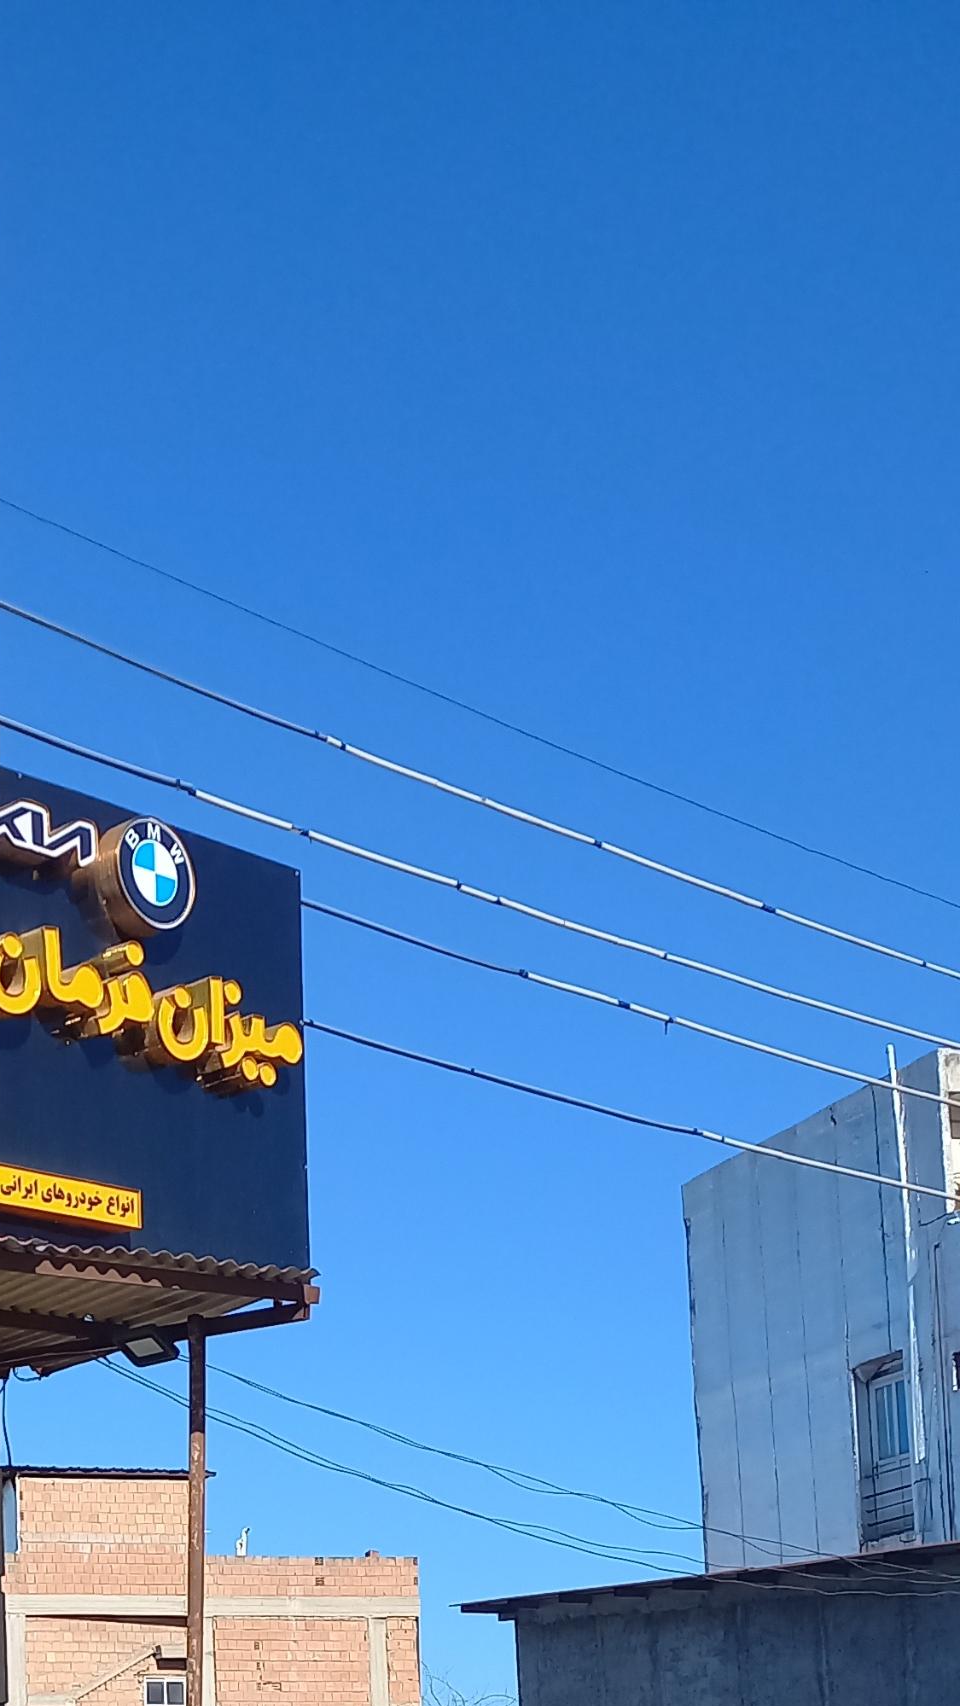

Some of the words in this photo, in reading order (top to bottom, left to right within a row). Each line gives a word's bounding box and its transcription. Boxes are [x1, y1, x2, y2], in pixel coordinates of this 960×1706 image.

[124, 822, 185, 865] BMW
[158, 975, 303, 1087] میزان
[0, 1174, 39, 1200] ایرانی
[40, 1182, 103, 1212] خودروهای
[105, 1194, 135, 1218] انواع
